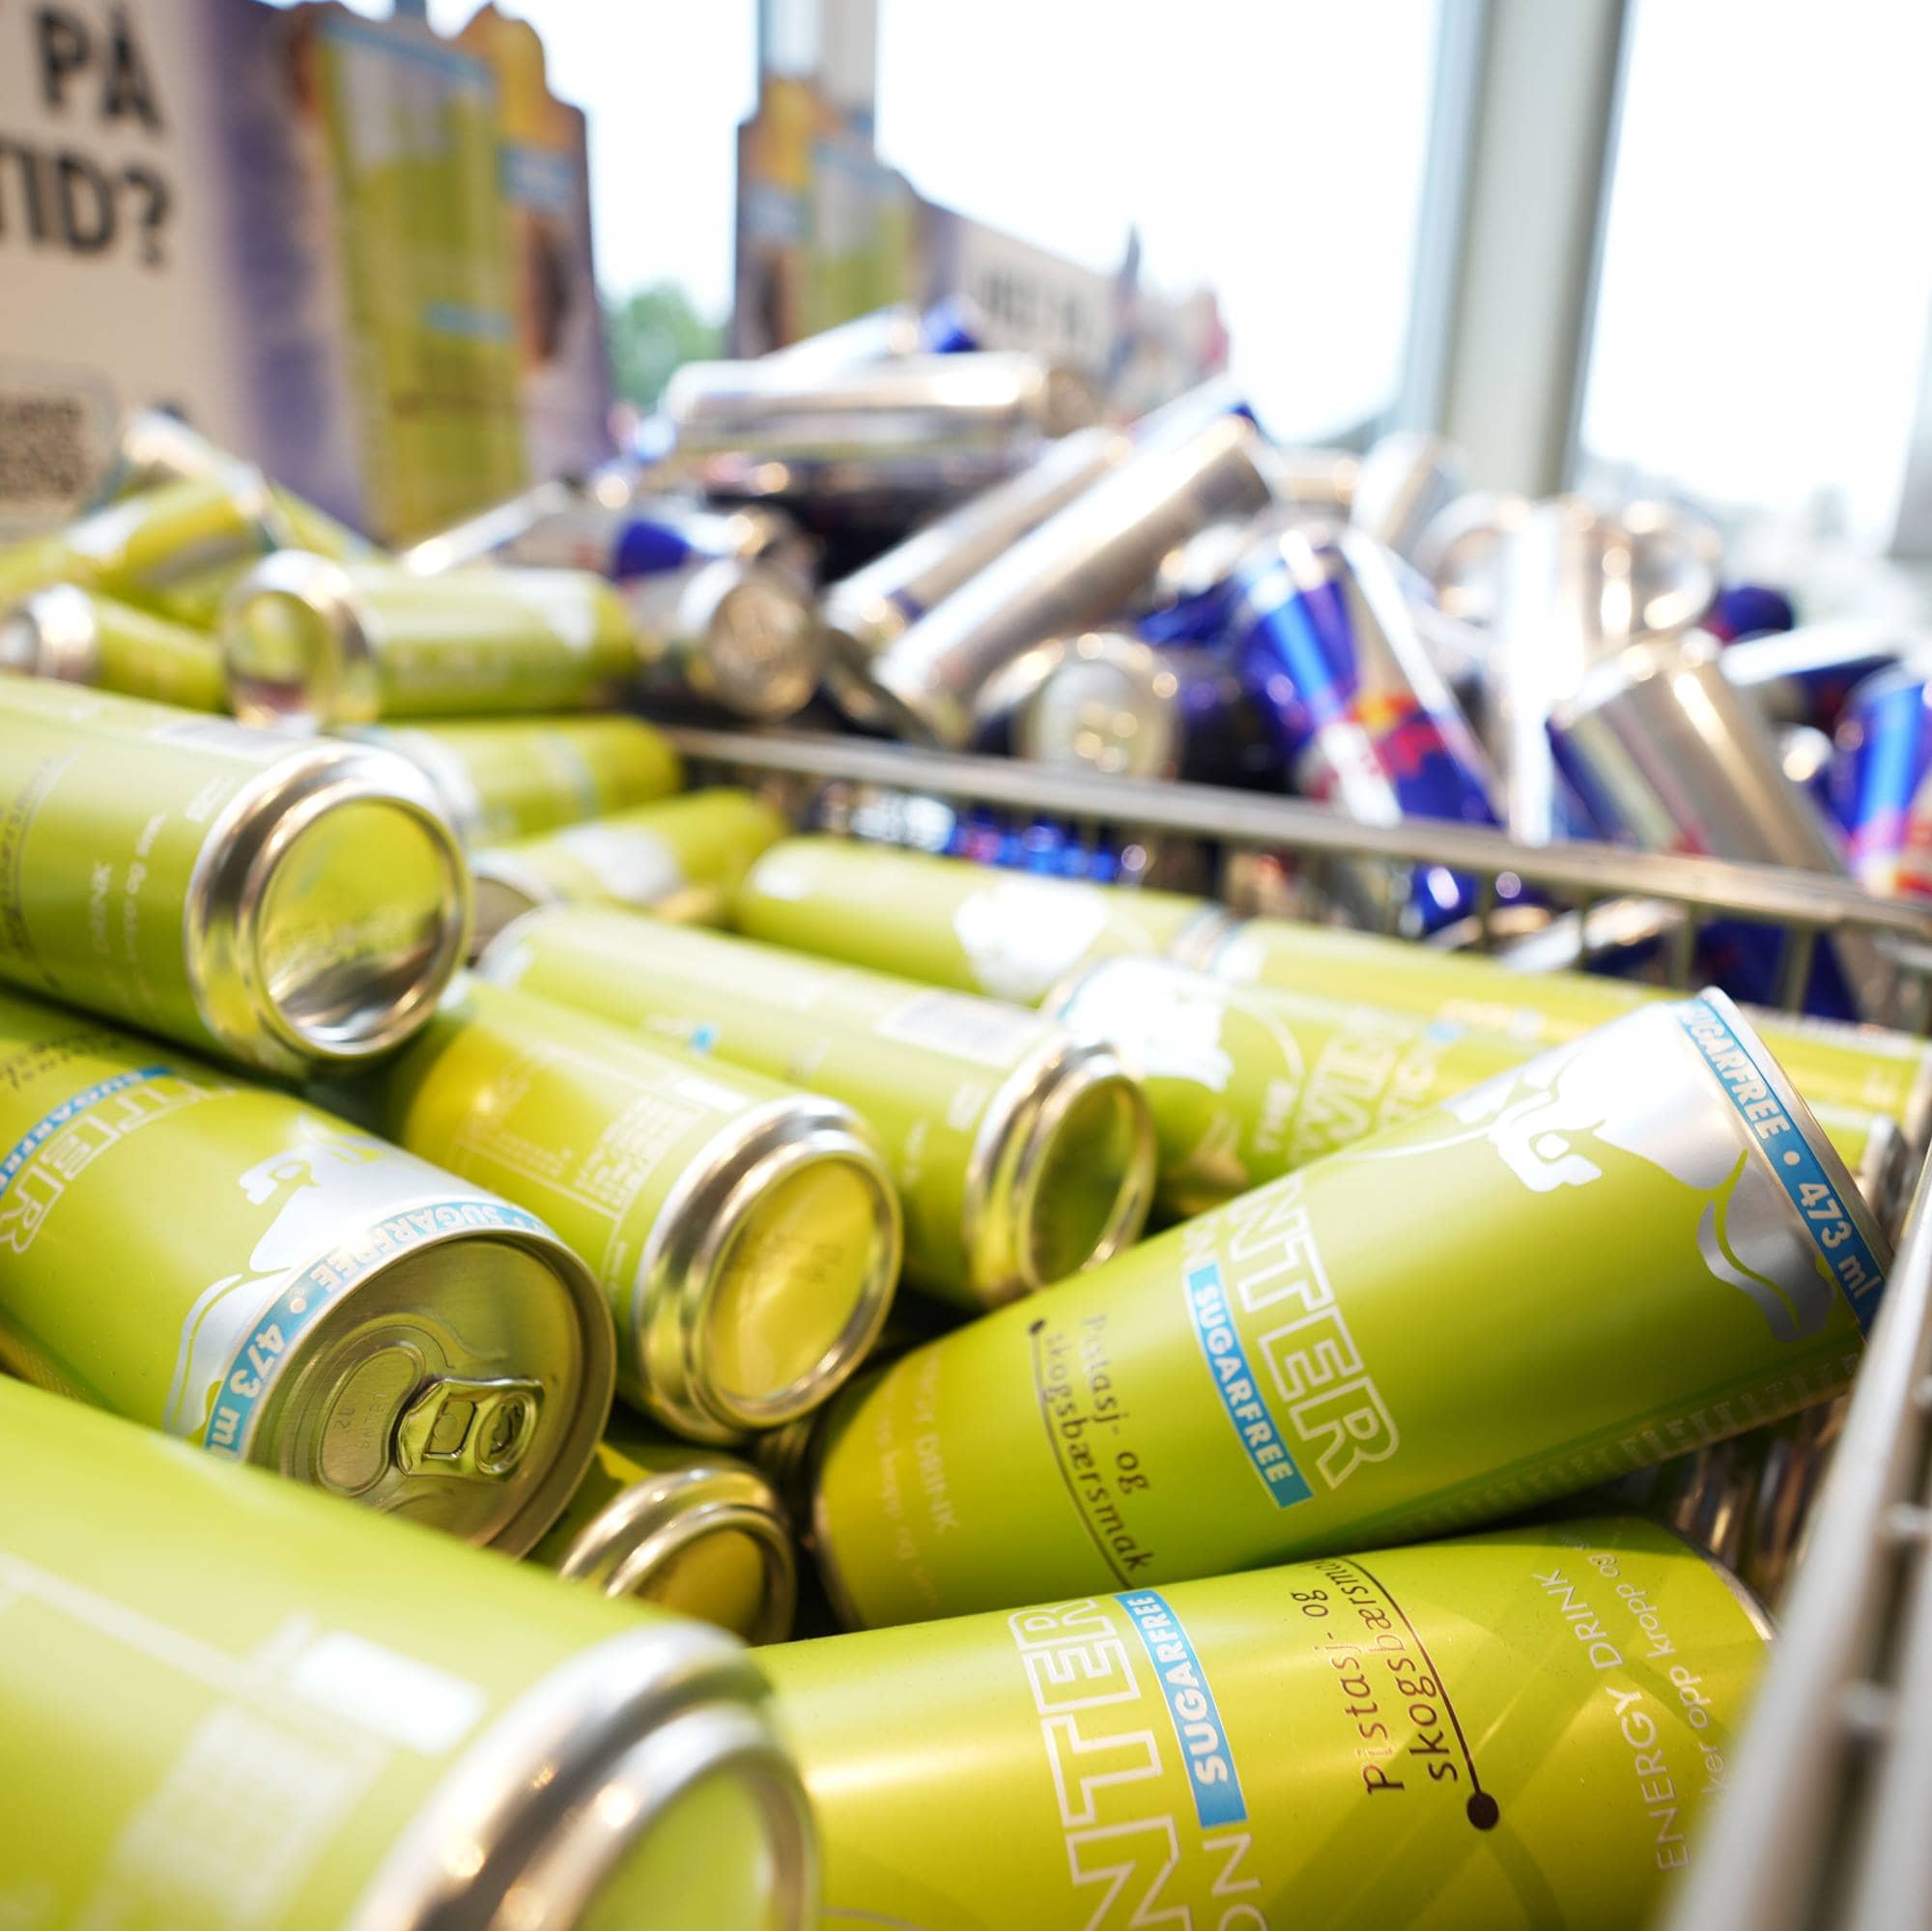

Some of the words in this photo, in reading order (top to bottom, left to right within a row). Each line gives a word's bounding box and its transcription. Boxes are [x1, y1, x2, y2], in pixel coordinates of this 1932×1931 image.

[35, 2, 169, 137] PÅ
[0, 1071, 144, 1188] SUGARFR
[1683, 1008, 1791, 1140] UGARFREE
[1799, 1182, 1853, 1249] 473
[1838, 1255, 1883, 1299] ml
[310, 1202, 508, 1293] SUGARFREE
[230, 1321, 287, 1399] 473
[1195, 1283, 1293, 1484] SUGARFREE
[1042, 1332, 1154, 1572] skogsbærsmak
[1115, 1450, 1151, 1495] og
[1291, 1589, 1330, 1618] og
[1531, 1568, 1624, 1670] DRINK
[1587, 1553, 1620, 1578] og
[1615, 1583, 1676, 1658] kropp
[1126, 1595, 1230, 1786] SUGARFREE
[1314, 1632, 1406, 1796] Pistasj-
[1668, 1665, 1712, 1729] opp
[1605, 1687, 1690, 1871] ENERGY
